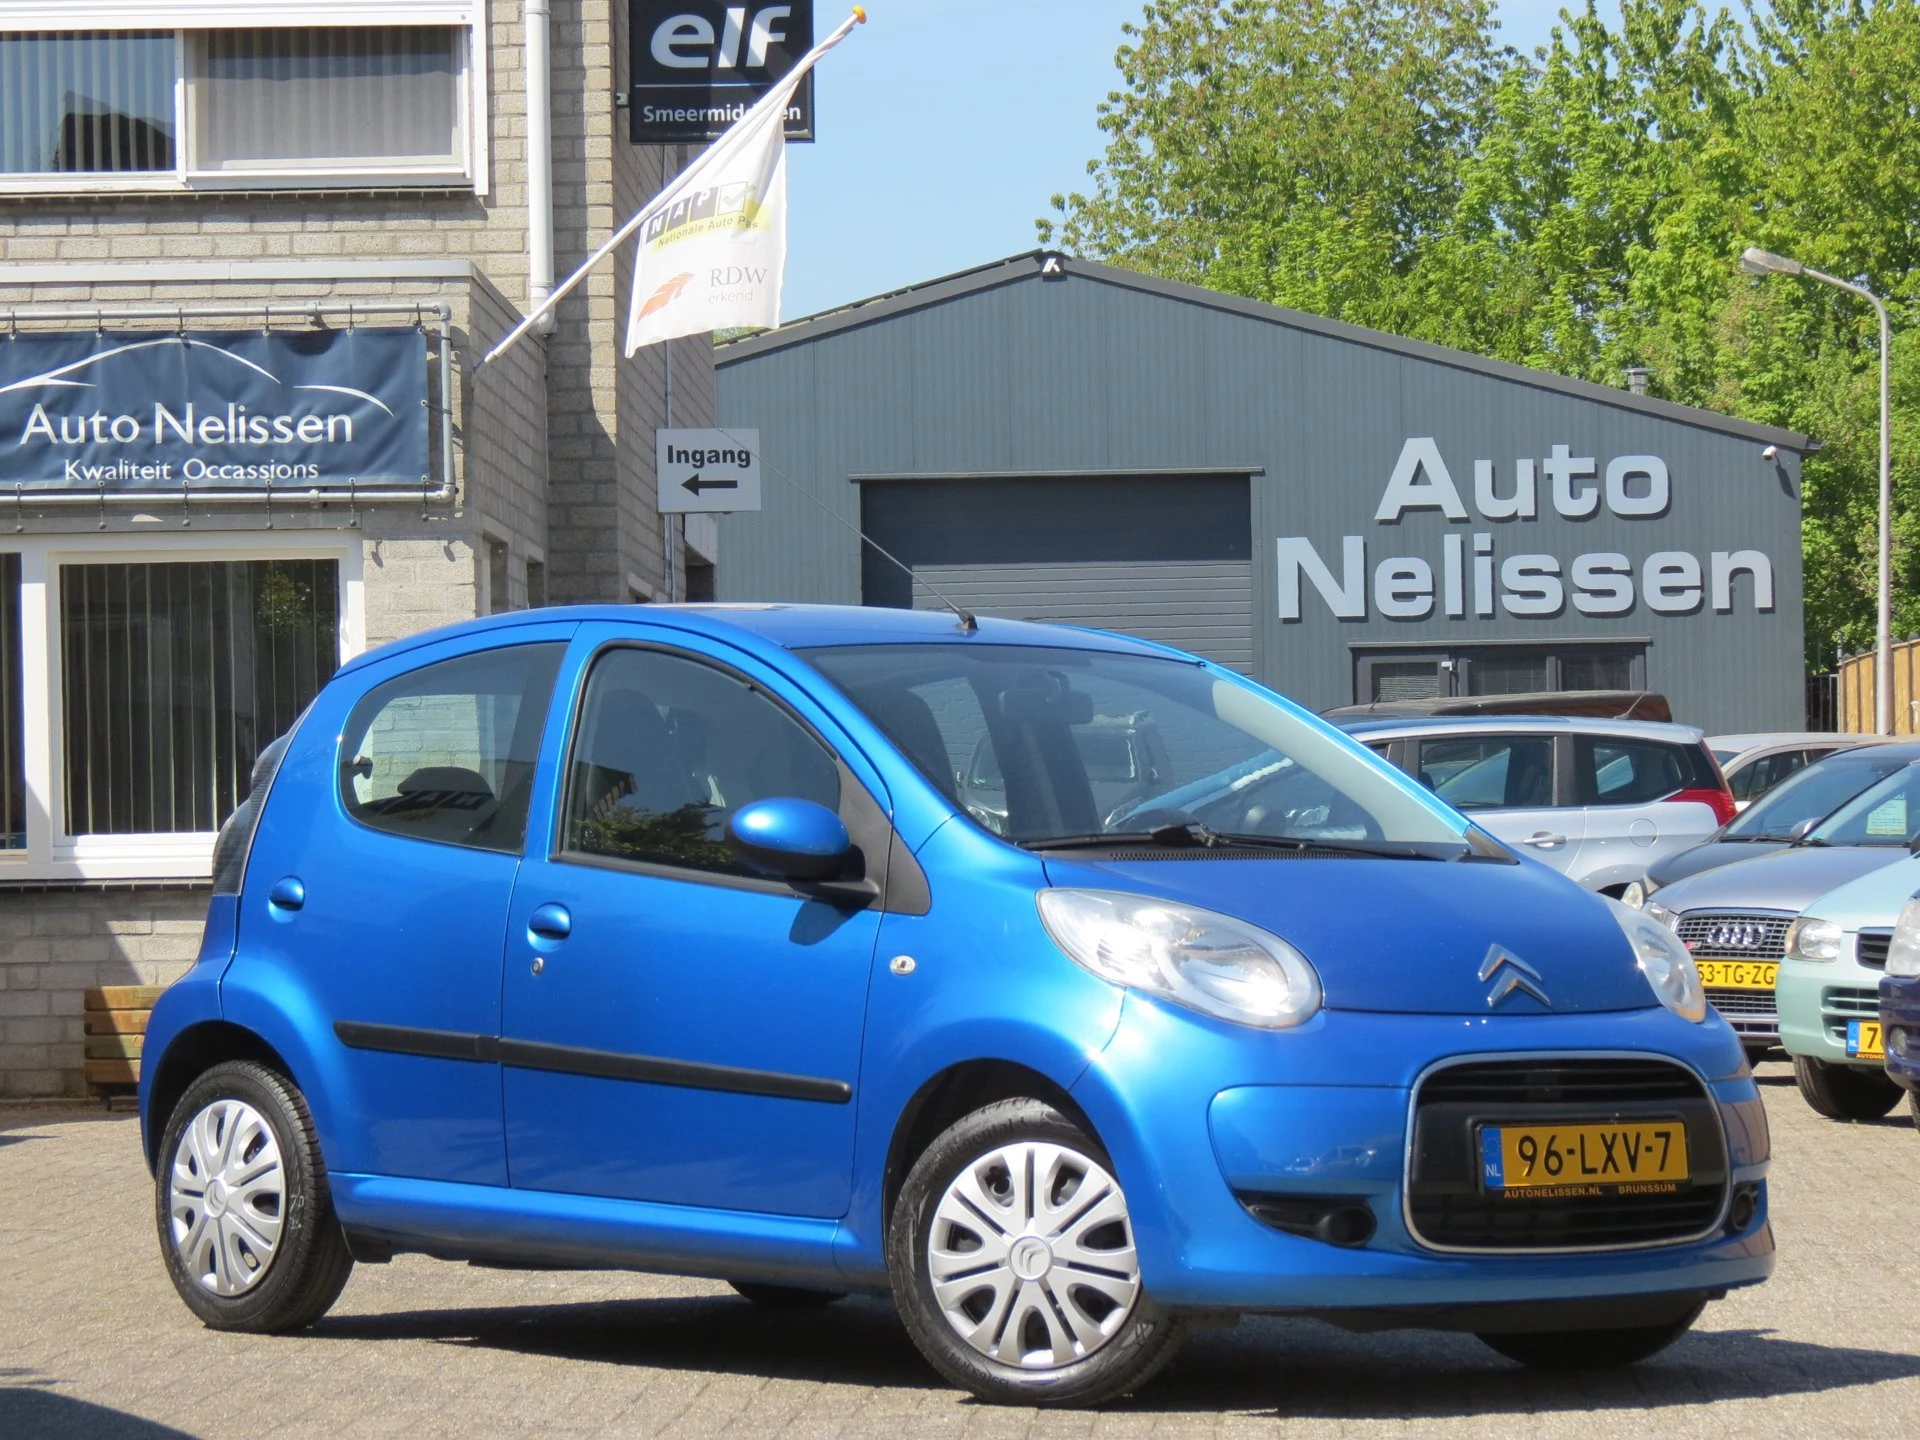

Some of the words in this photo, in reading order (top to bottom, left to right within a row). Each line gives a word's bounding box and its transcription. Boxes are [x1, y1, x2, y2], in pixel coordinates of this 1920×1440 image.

[651, 6, 791, 68] elf
[643, 103, 801, 122] Smeermiden
[658, 225, 705, 248] Nationale
[708, 217, 733, 231] Auto
[710, 266, 767, 287] RDW
[707, 288, 753, 304] erkend
[19, 403, 140, 446] Auto
[154, 402, 353, 445] Nelissen
[667, 444, 751, 469] Ingang
[64, 459, 172, 481] Kwaliteit
[183, 458, 320, 481] Occassions
[1374, 437, 1670, 520] Auto
[1276, 532, 1774, 620] Nelissen
[1517, 1131, 1672, 1177] 96-LXV-7
[1485, 1164, 1501, 1177] NL
[1504, 1187, 1603, 1199] AUTONELISSEN.NL
[1618, 1183, 1677, 1194] BRUNSSUM
